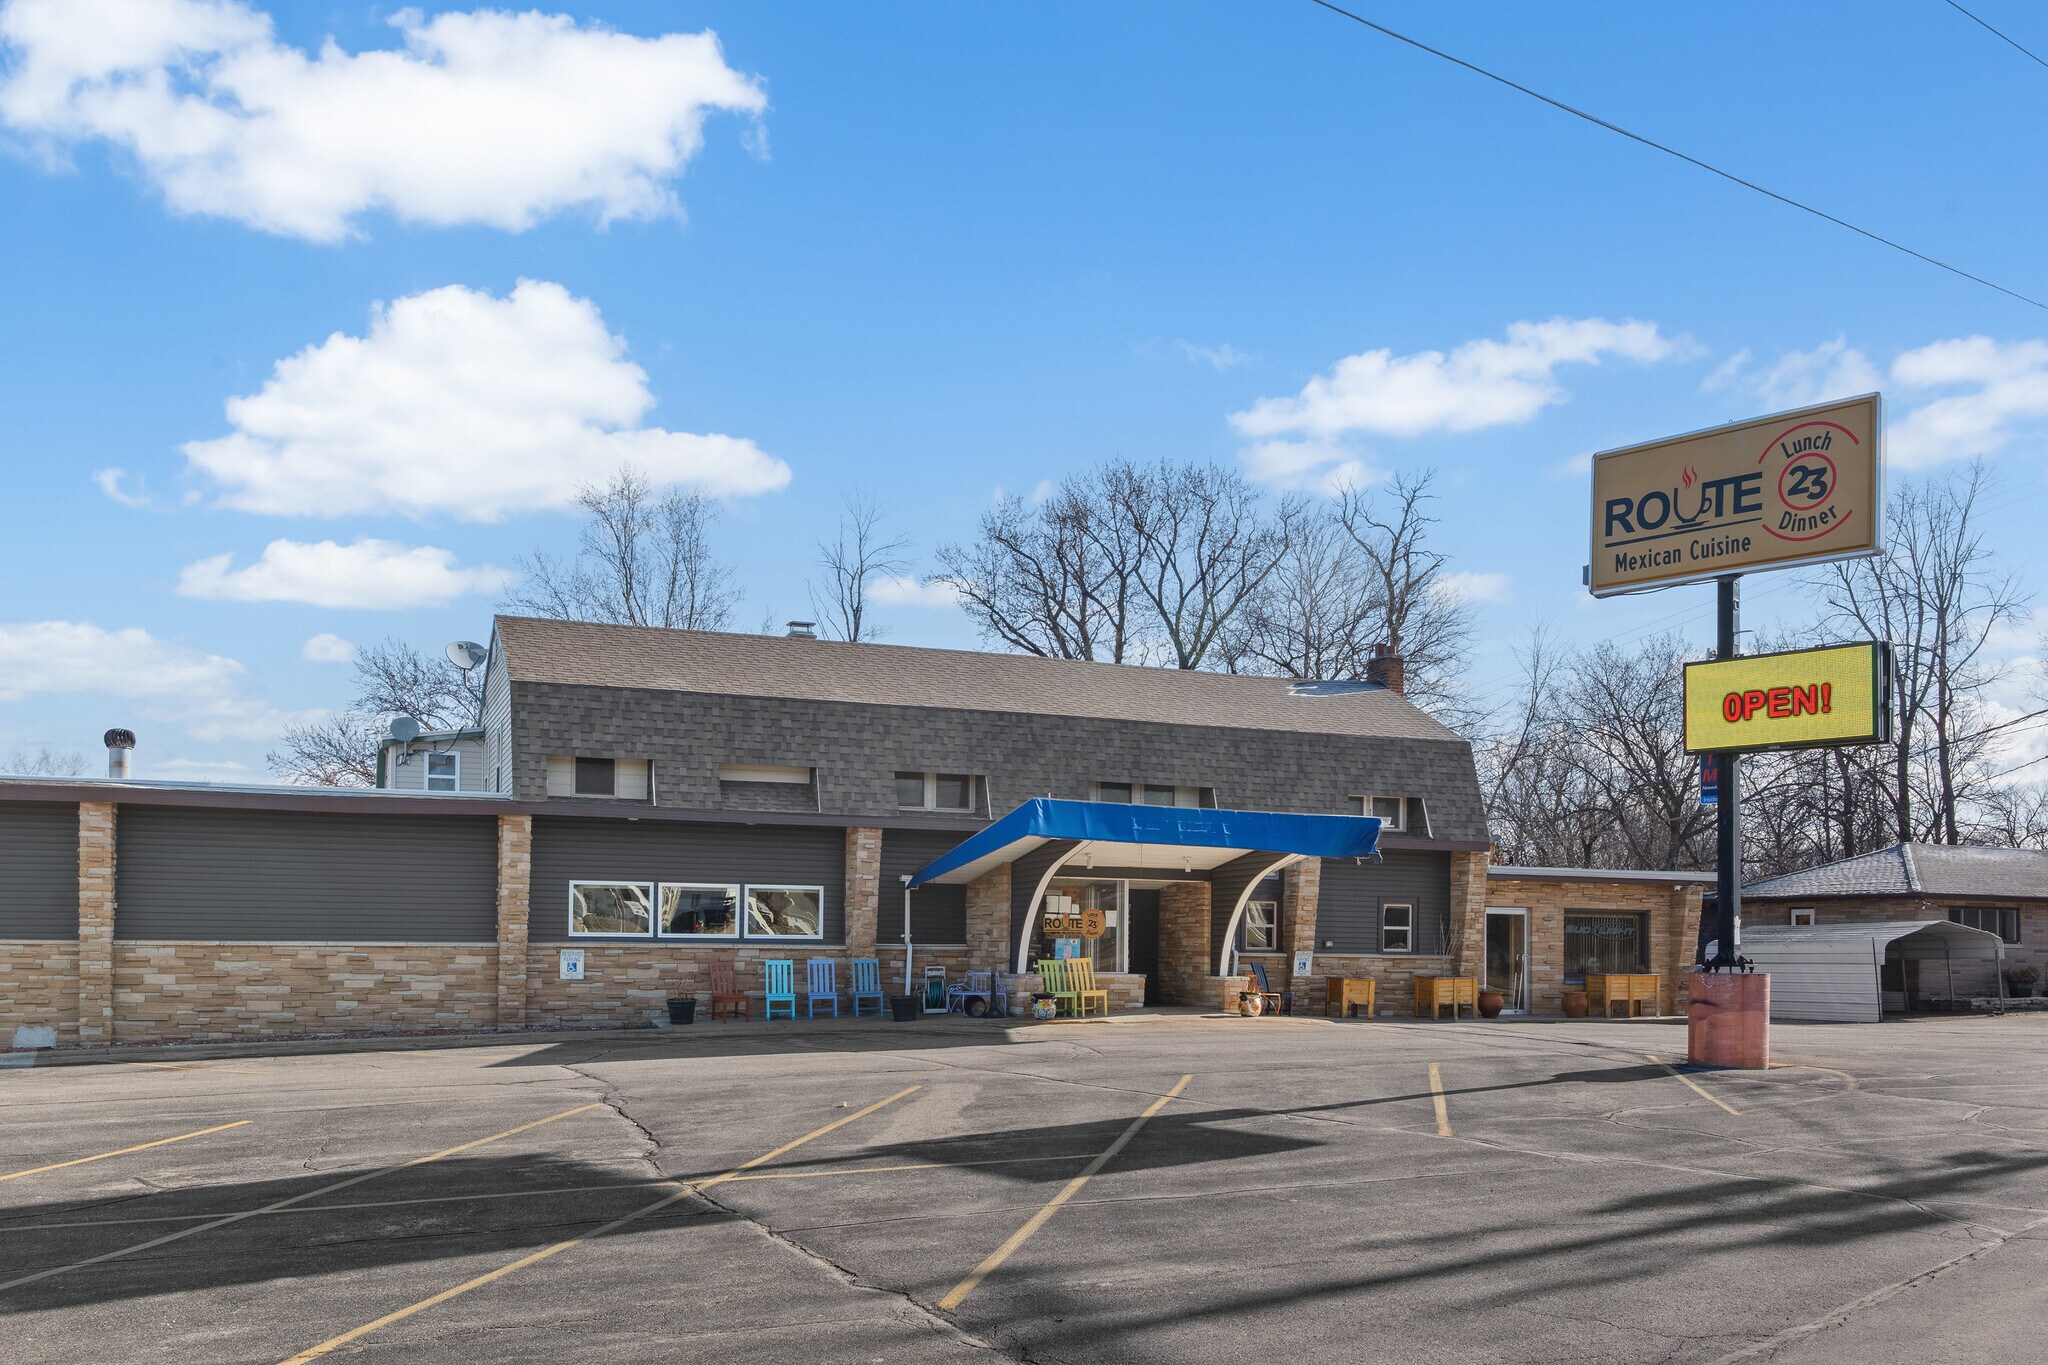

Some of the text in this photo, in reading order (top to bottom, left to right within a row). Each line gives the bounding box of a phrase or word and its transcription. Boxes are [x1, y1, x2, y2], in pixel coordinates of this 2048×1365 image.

[1781, 430, 1833, 459] Lunch
[1787, 465, 1828, 500] 23
[1605, 471, 1763, 537] ROUTE
[1778, 505, 1837, 532] Dinner
[1615, 535, 1752, 573] Mexican Cuisine
[1723, 682, 1832, 723] OPEN!
[1044, 918, 1083, 929] ROUTE
[1088, 919, 1097, 929] 23
